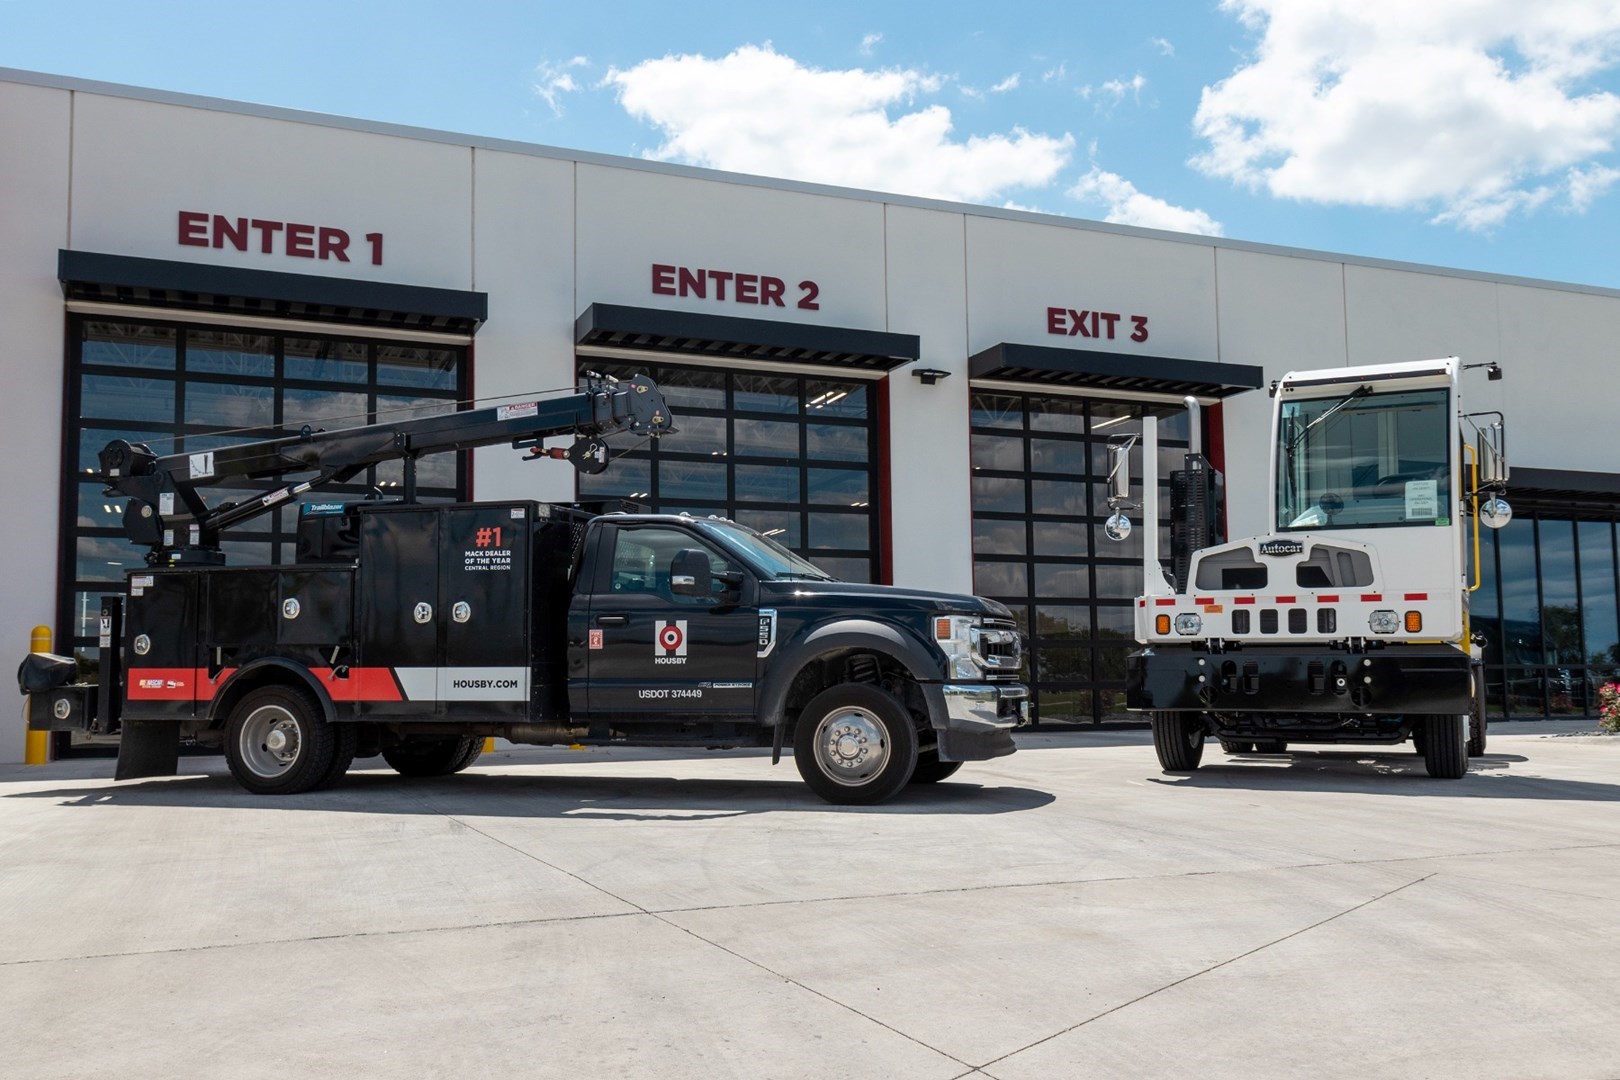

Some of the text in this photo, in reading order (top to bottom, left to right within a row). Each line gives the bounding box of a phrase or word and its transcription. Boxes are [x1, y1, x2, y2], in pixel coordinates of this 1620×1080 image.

[178, 211, 383, 266] ENTER 1
[651, 263, 820, 311] ENTER 2
[1047, 306, 1149, 343] EXIT 3
[311, 503, 343, 511] Trailblazer
[475, 526, 502, 547] #1
[1260, 543, 1302, 554] Autocar
[654, 657, 687, 665] HOUSBY
[453, 679, 518, 689] HOUSBY.COM
[638, 689, 703, 699] USDOT 374449
